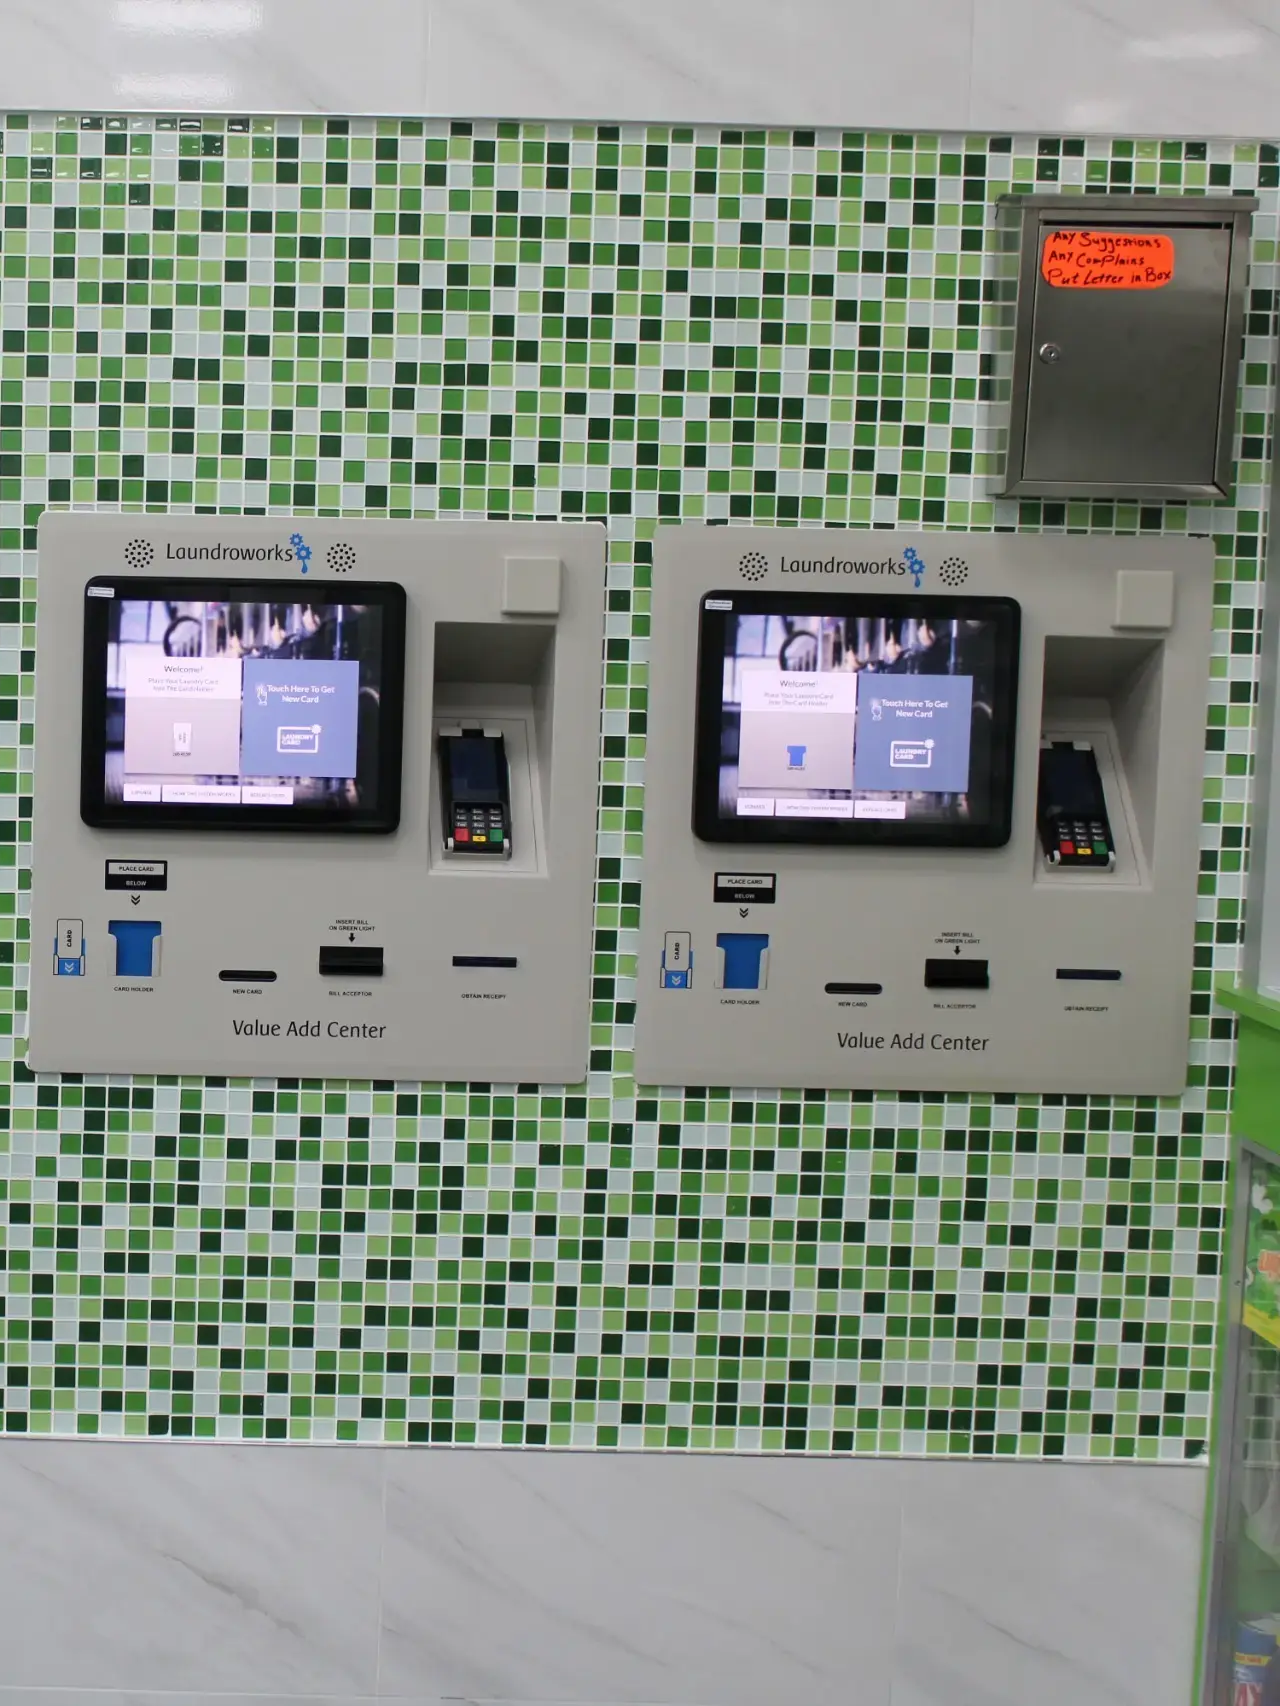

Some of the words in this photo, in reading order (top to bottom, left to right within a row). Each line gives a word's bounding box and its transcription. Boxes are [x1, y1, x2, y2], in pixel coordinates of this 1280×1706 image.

[1079, 232, 1161, 253] Suggestions
[1048, 268, 1079, 284] Put
[1084, 270, 1123, 285] Letter
[1131, 274, 1141, 283] in
[1145, 267, 1171, 282] Box
[166, 543, 292, 562] Laundroworks
[781, 556, 905, 576] Laundroworks
[267, 684, 289, 692] Touch
[290, 685, 310, 693] Here
[282, 695, 300, 703] New
[301, 695, 319, 703] Card
[881, 699, 903, 707] Touch
[904, 700, 924, 708] Here
[924, 700, 933, 708] To
[934, 700, 948, 708] Get
[914, 710, 933, 718] Card
[233, 1019, 281, 1036] Value
[286, 1020, 321, 1037] Add
[327, 1021, 386, 1038] Center
[837, 1032, 885, 1049] Value
[890, 1033, 925, 1049] Add
[931, 1034, 989, 1051] Center
